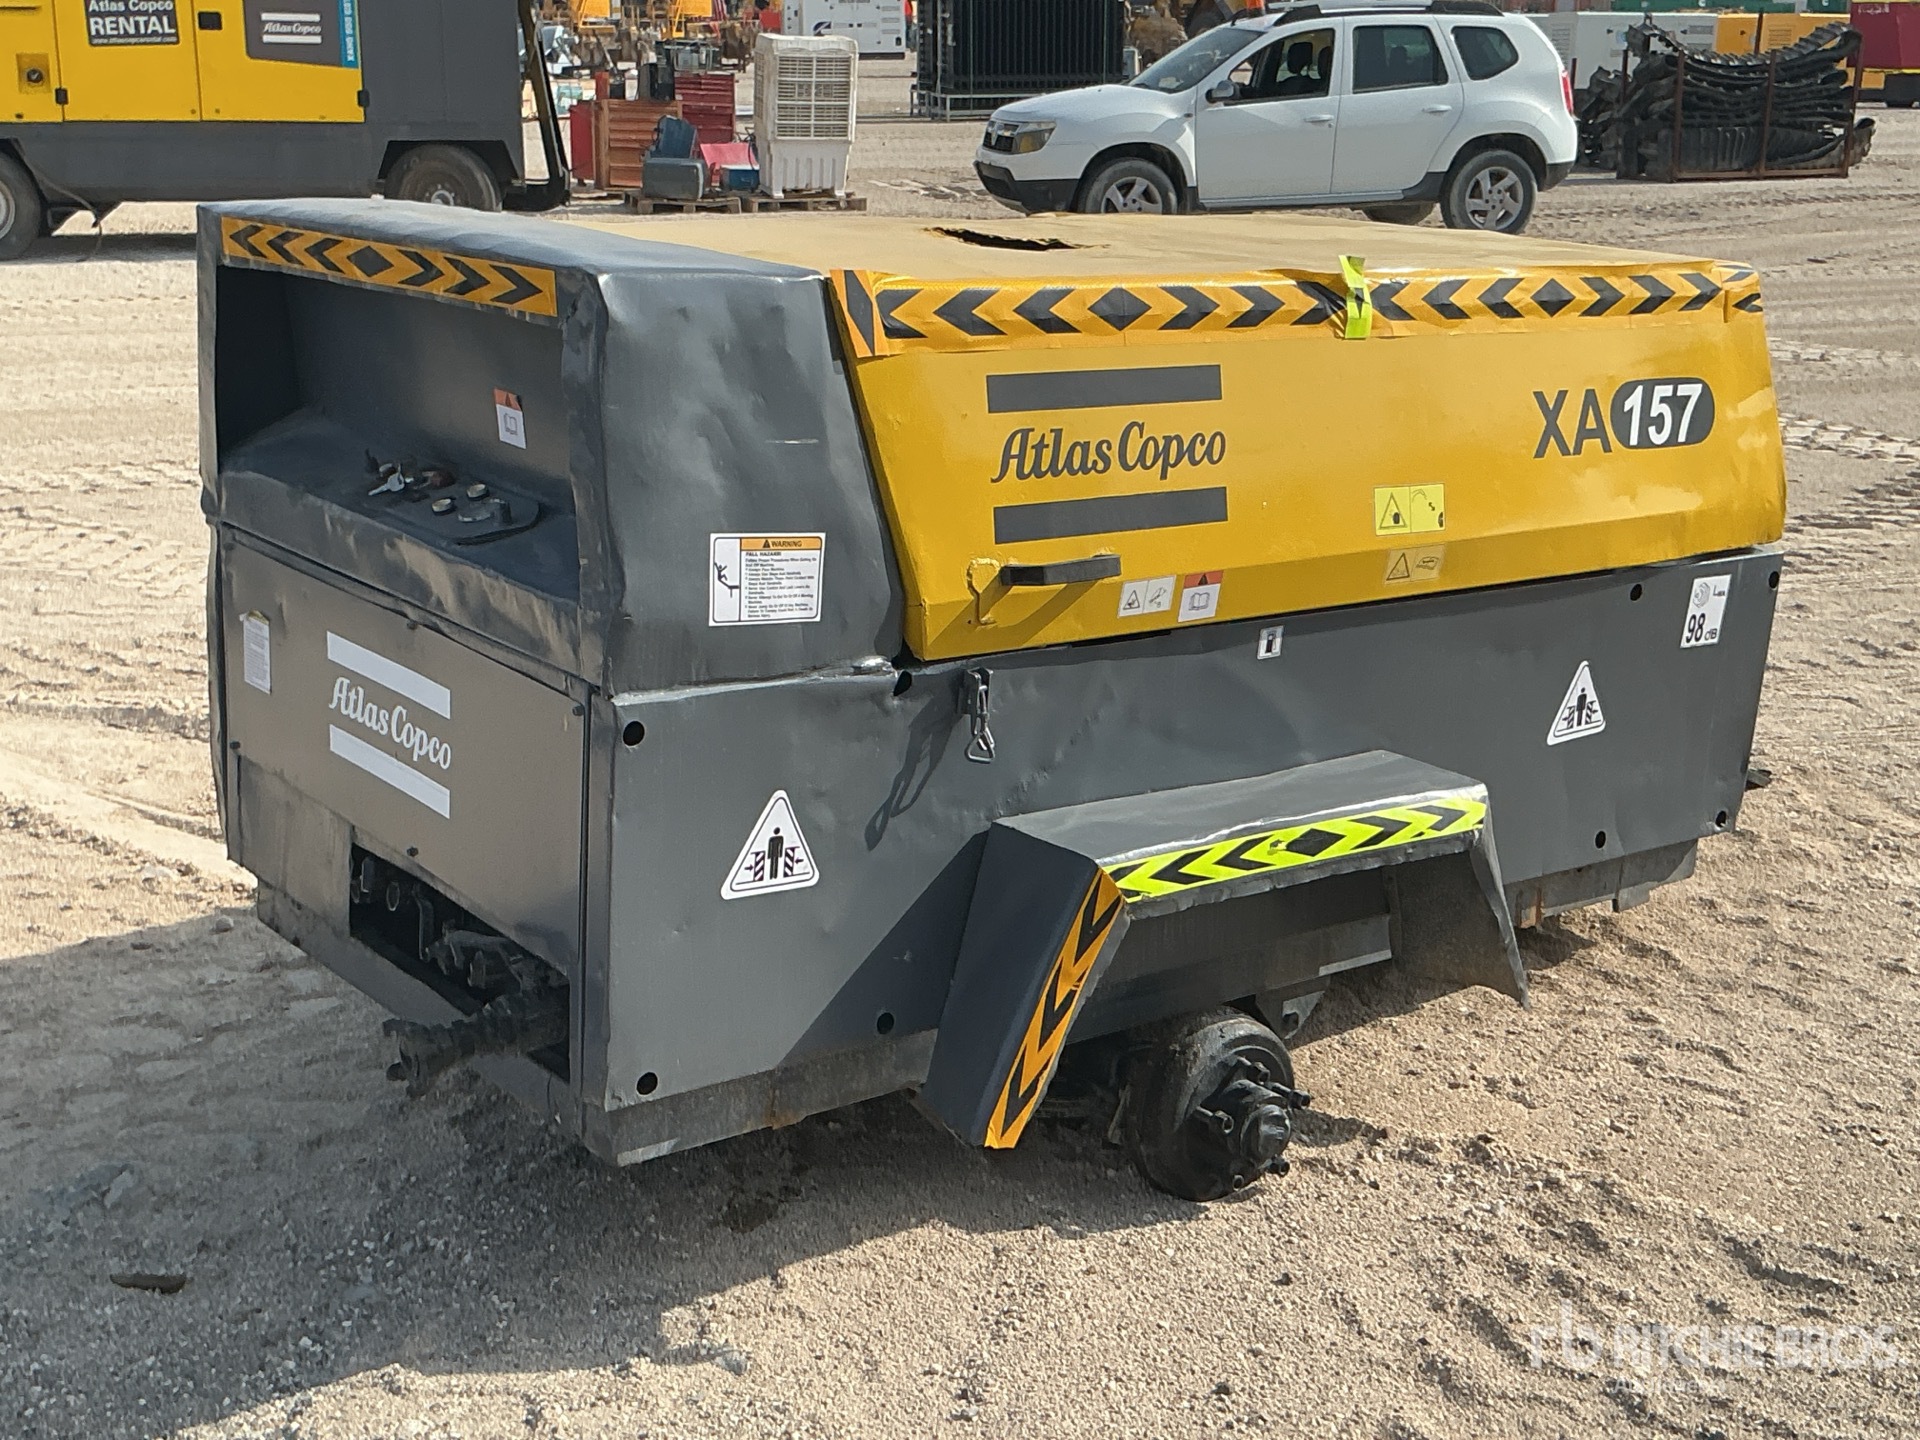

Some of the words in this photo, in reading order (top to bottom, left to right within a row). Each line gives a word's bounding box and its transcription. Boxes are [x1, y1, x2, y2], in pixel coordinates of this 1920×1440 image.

[89, 0, 126, 12] Atlas
[128, 0, 174, 13] Copco
[90, 15, 176, 36] RENTAL
[263, 22, 292, 33] Atlas
[292, 22, 321, 35] Copco
[1532, 388, 1613, 459] XA
[1623, 383, 1703, 448] 157
[990, 427, 1112, 484] Atlas
[1117, 420, 1226, 481] Copco
[771, 540, 802, 548] WARNING
[1686, 613, 1706, 643] 98
[1704, 628, 1717, 641] dB
[329, 676, 390, 736] Atlas
[391, 705, 452, 770] Copco
